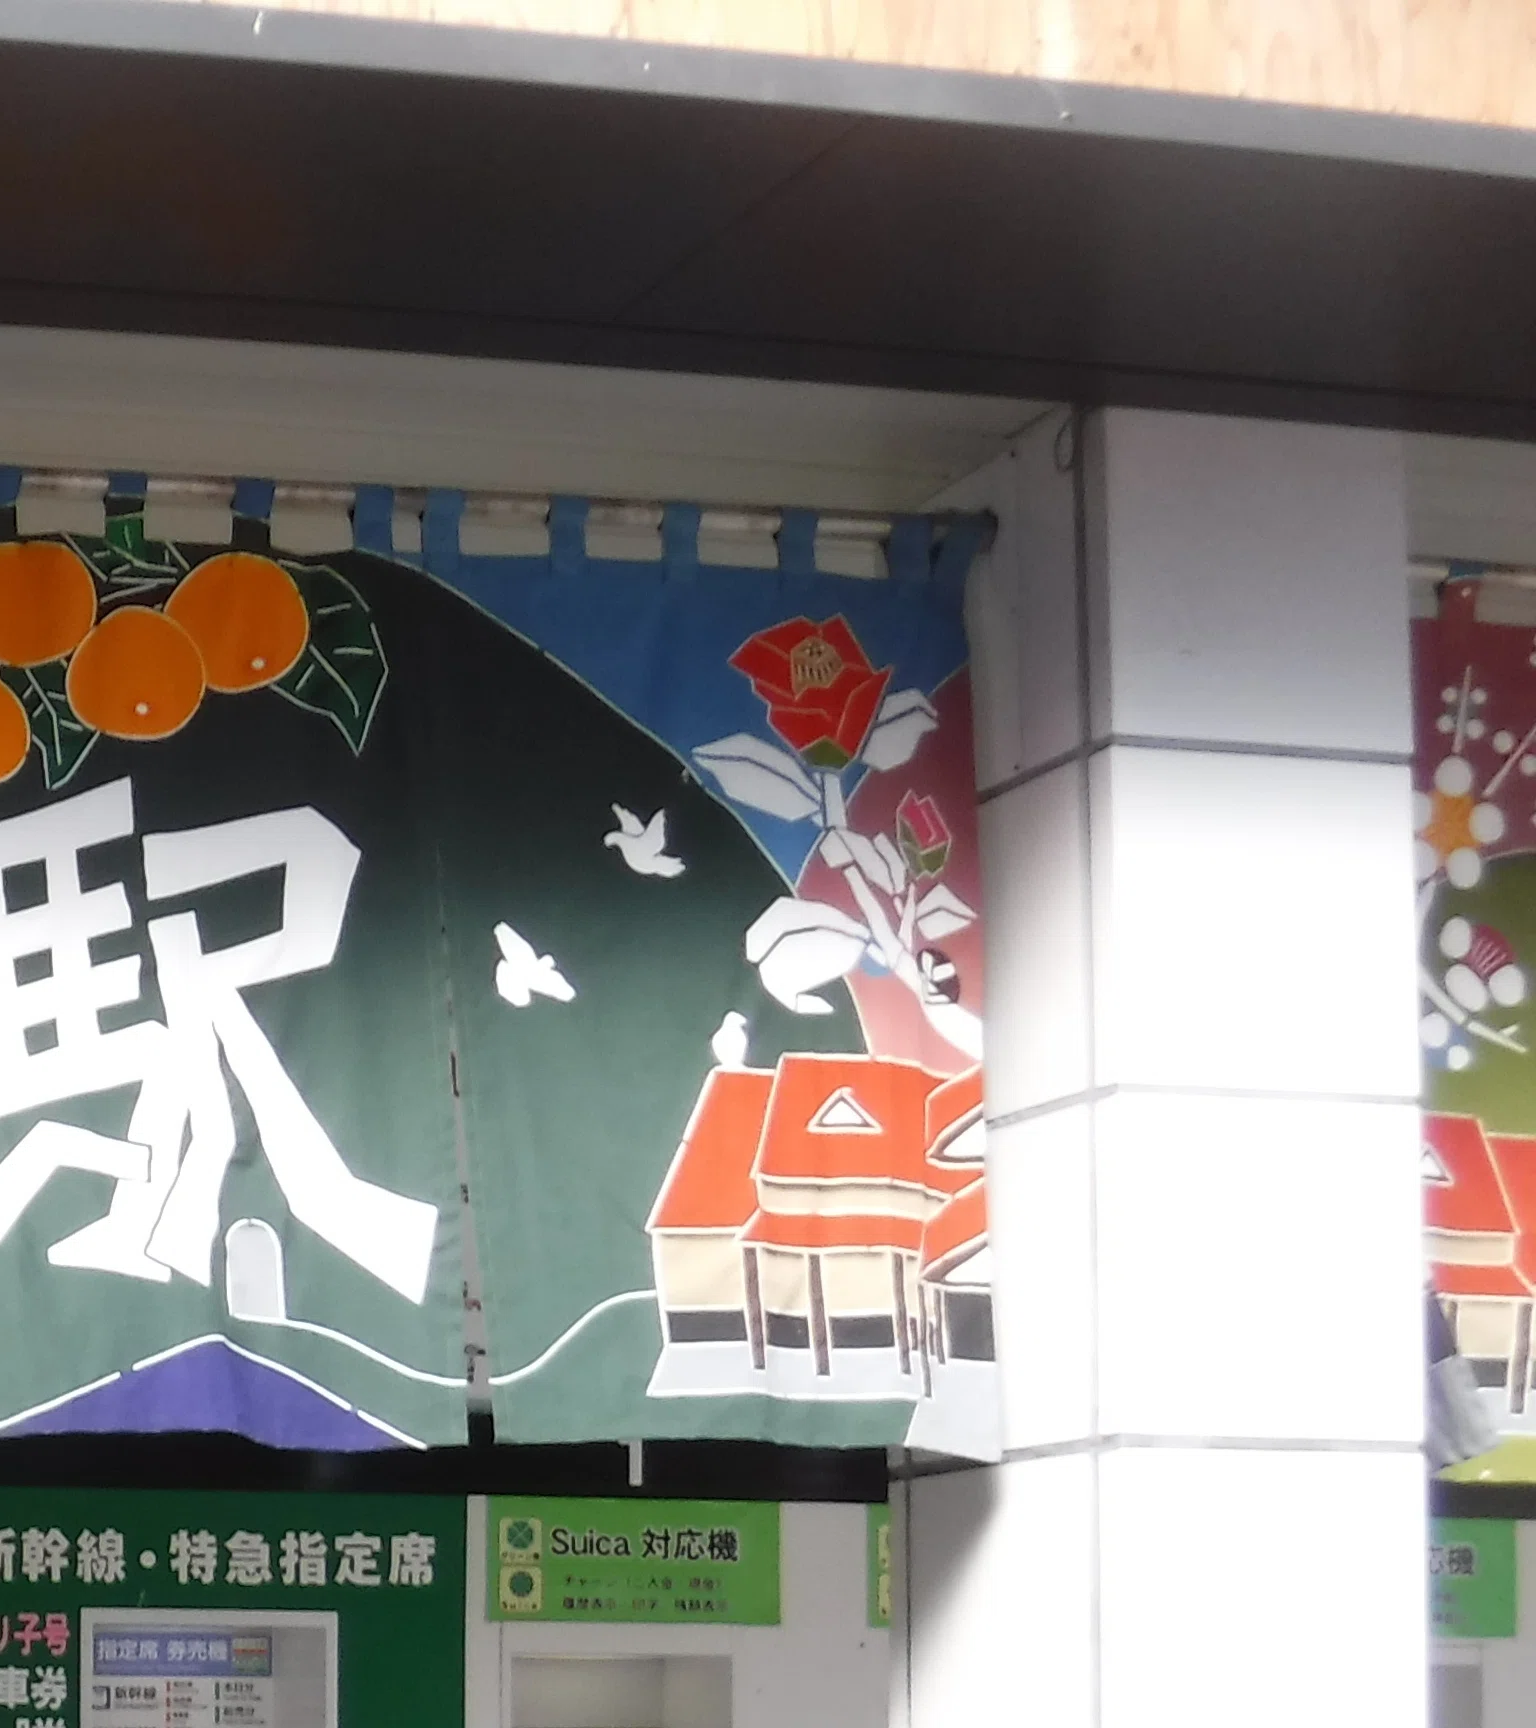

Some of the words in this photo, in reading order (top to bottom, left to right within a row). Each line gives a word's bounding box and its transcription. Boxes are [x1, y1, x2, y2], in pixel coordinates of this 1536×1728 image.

[551, 1528, 631, 1557] Suica
[641, 1527, 738, 1562] 対応機
